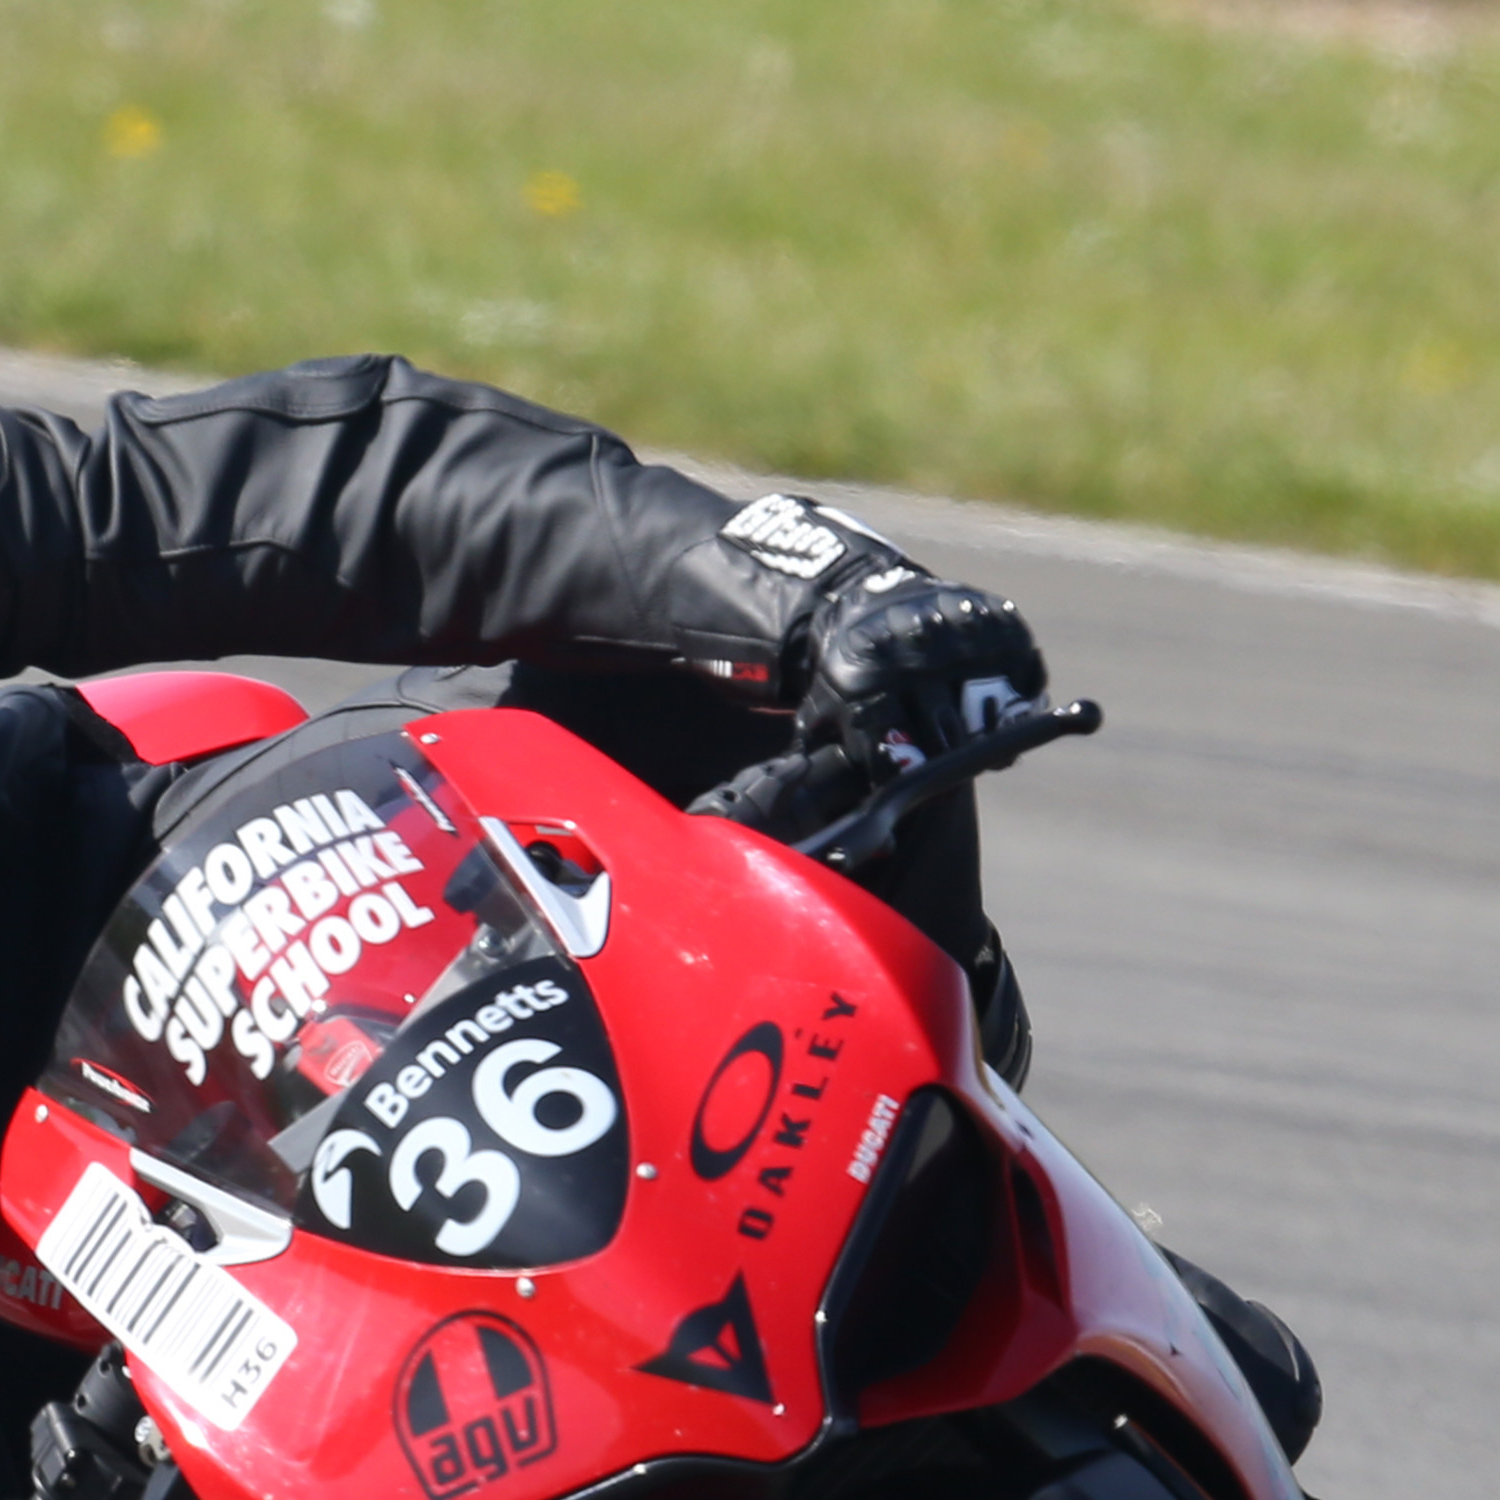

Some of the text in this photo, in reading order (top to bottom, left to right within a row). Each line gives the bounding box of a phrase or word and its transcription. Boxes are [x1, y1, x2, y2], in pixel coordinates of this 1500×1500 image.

[123, 790, 384, 1043] CALIFORNIA
[165, 831, 424, 1085] SUPERBIKE
[231, 882, 434, 1078] SCHOOL
[365, 979, 569, 1127] Bennetts
[389, 1039, 618, 1256] 36
[739, 992, 859, 1240] OAKLEY
[846, 1094, 900, 1184] DUCATI
[221, 1341, 278, 1409] H36
[430, 1396, 537, 1485] agv
